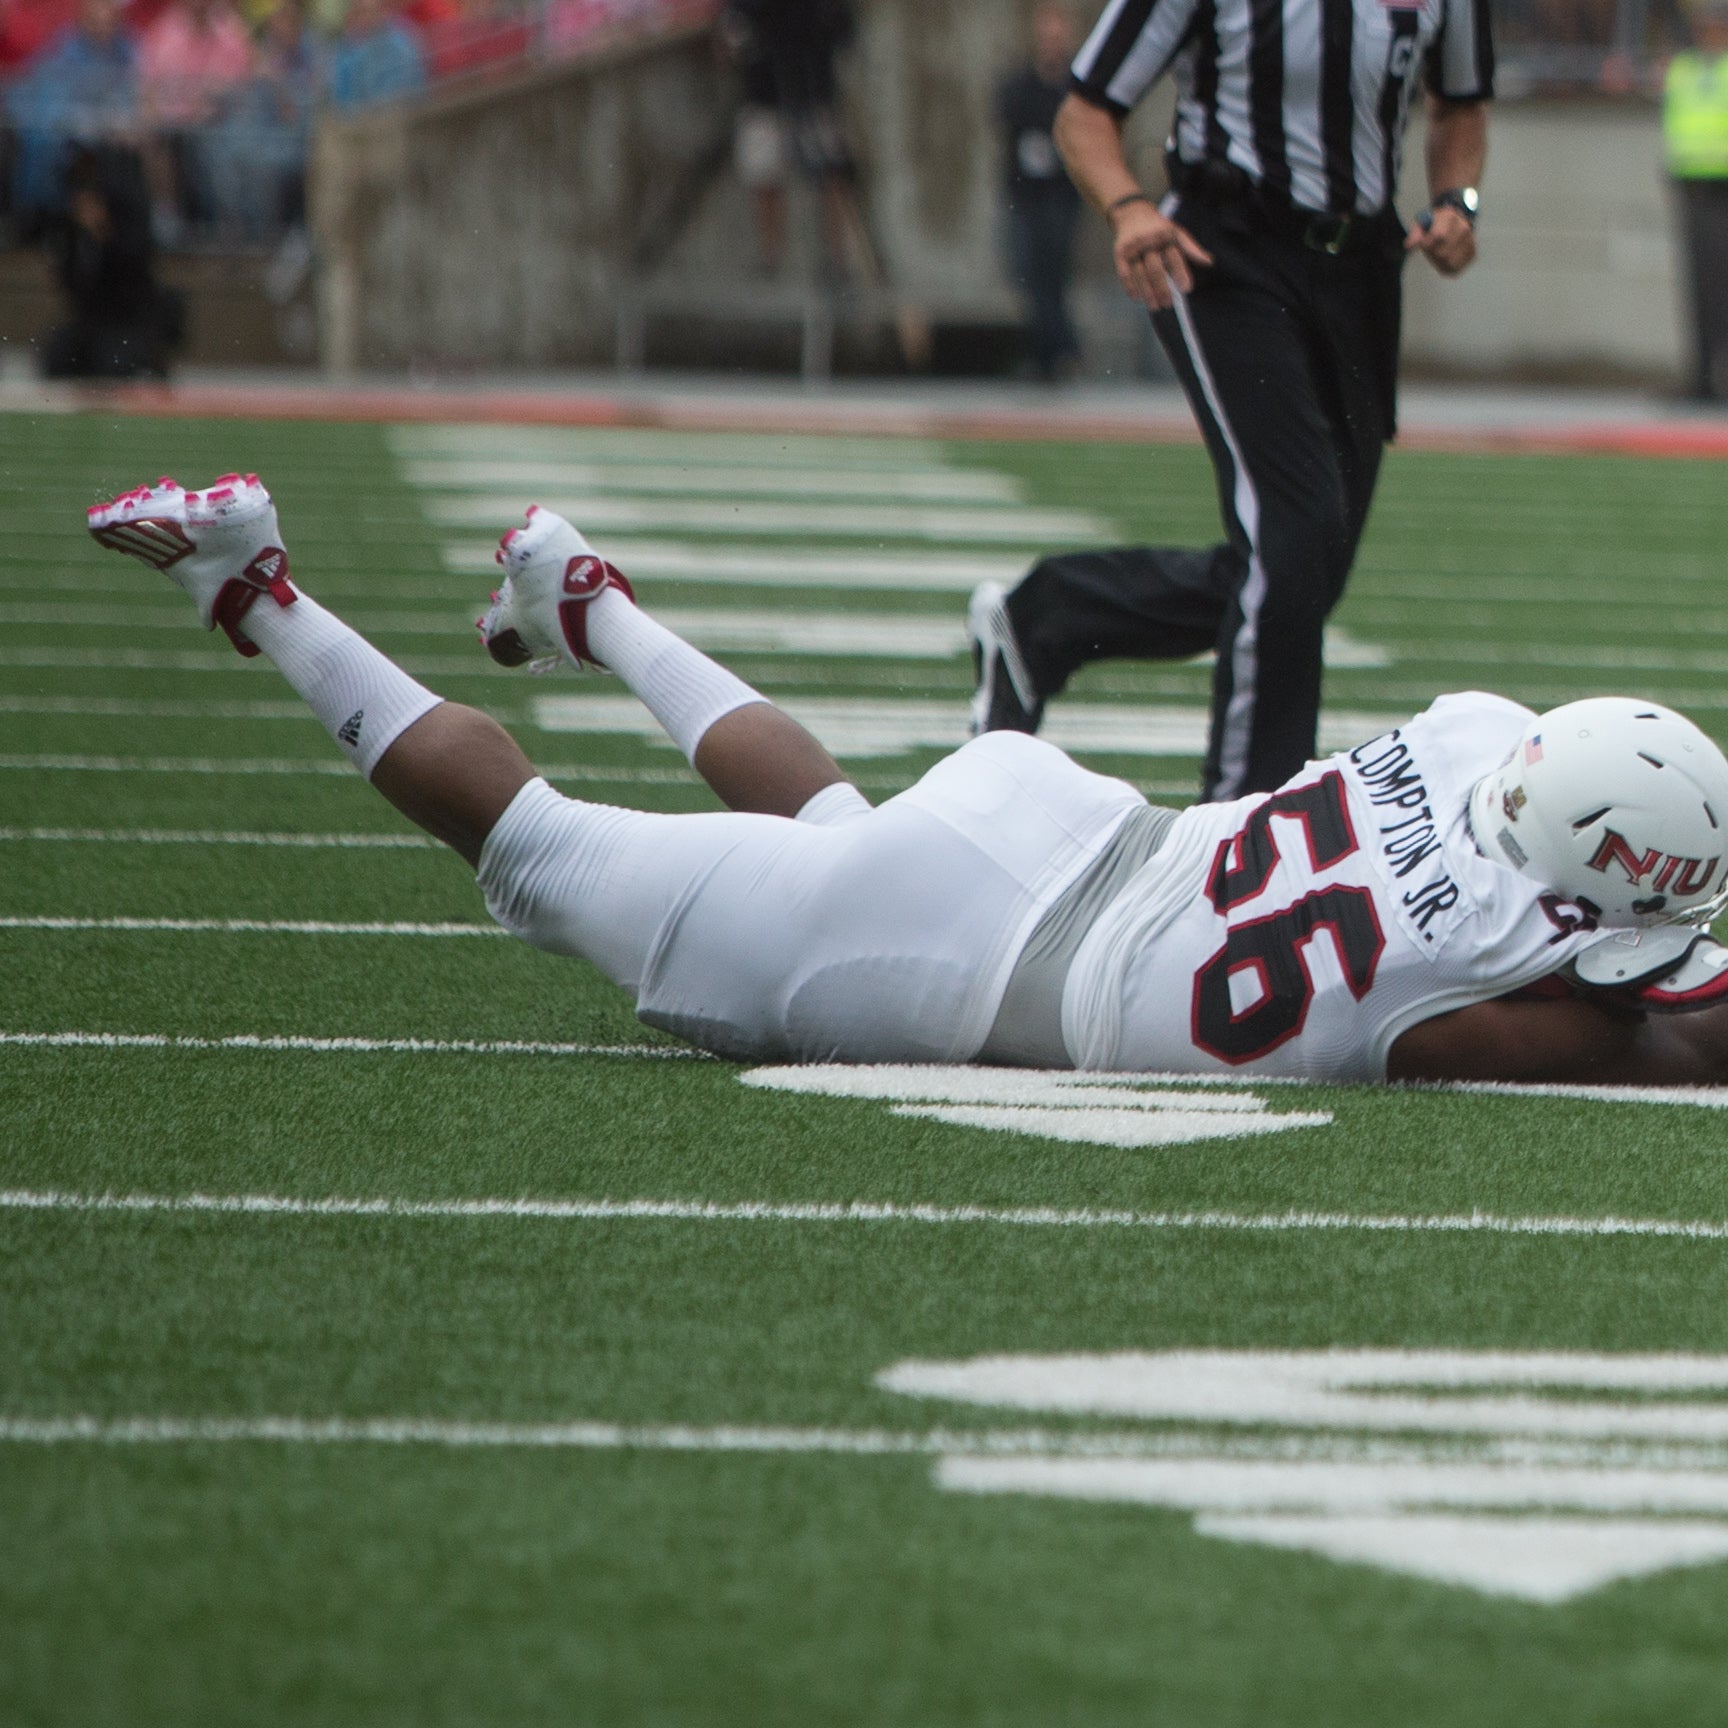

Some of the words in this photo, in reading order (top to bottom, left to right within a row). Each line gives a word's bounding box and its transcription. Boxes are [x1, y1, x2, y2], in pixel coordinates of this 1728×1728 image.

[1190, 769, 1387, 1066] 56
[1349, 729, 1443, 878] COMPTON
[1402, 881, 1460, 942] JR.
[1584, 826, 1720, 896] NIU
